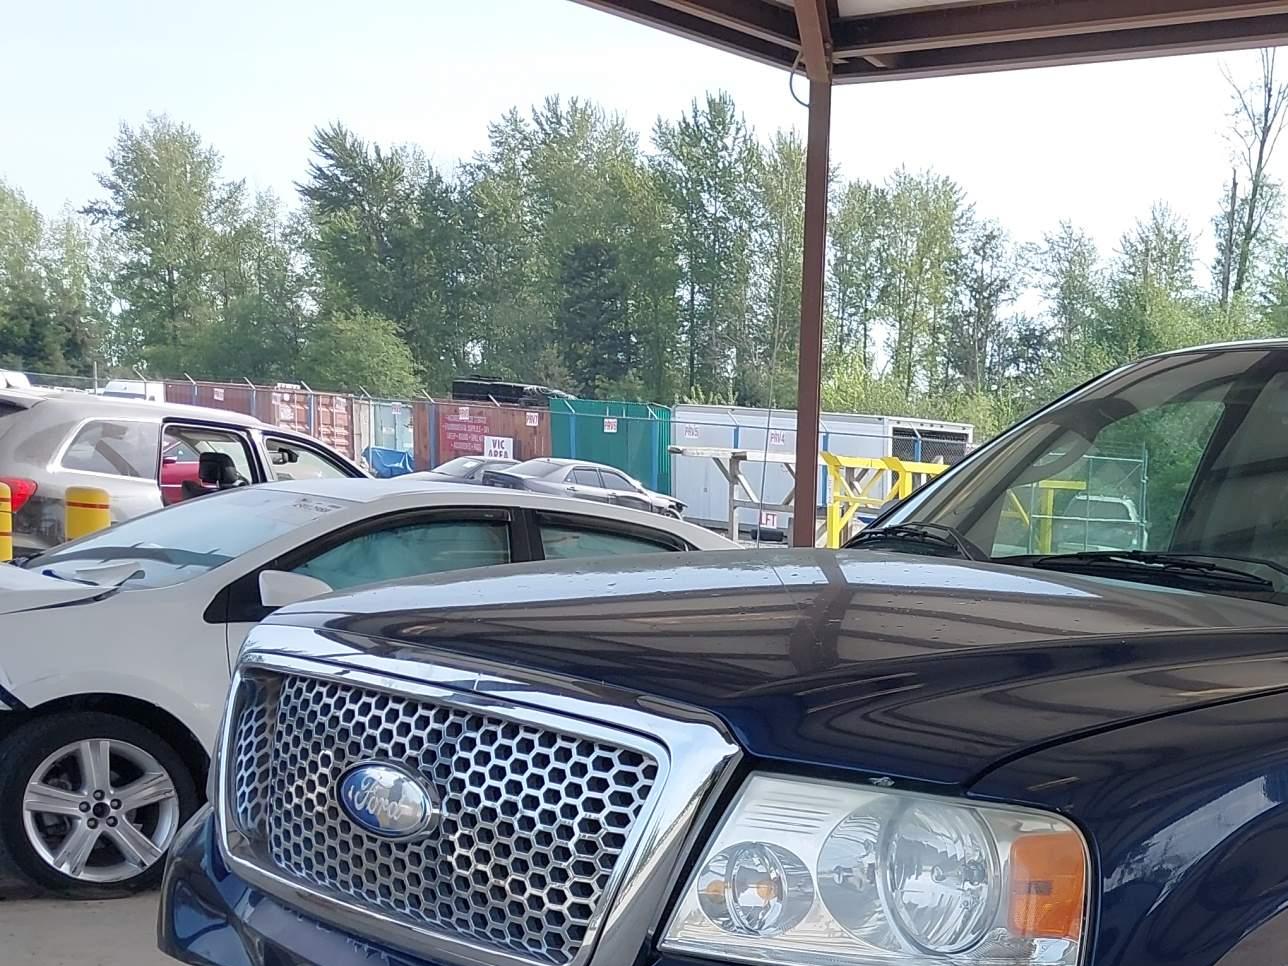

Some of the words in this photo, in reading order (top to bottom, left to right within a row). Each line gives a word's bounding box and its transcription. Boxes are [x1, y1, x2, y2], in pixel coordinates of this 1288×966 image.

[492, 439, 505, 450] VIC
[488, 450, 509, 459] AREA
[350, 774, 402, 821] Ford
